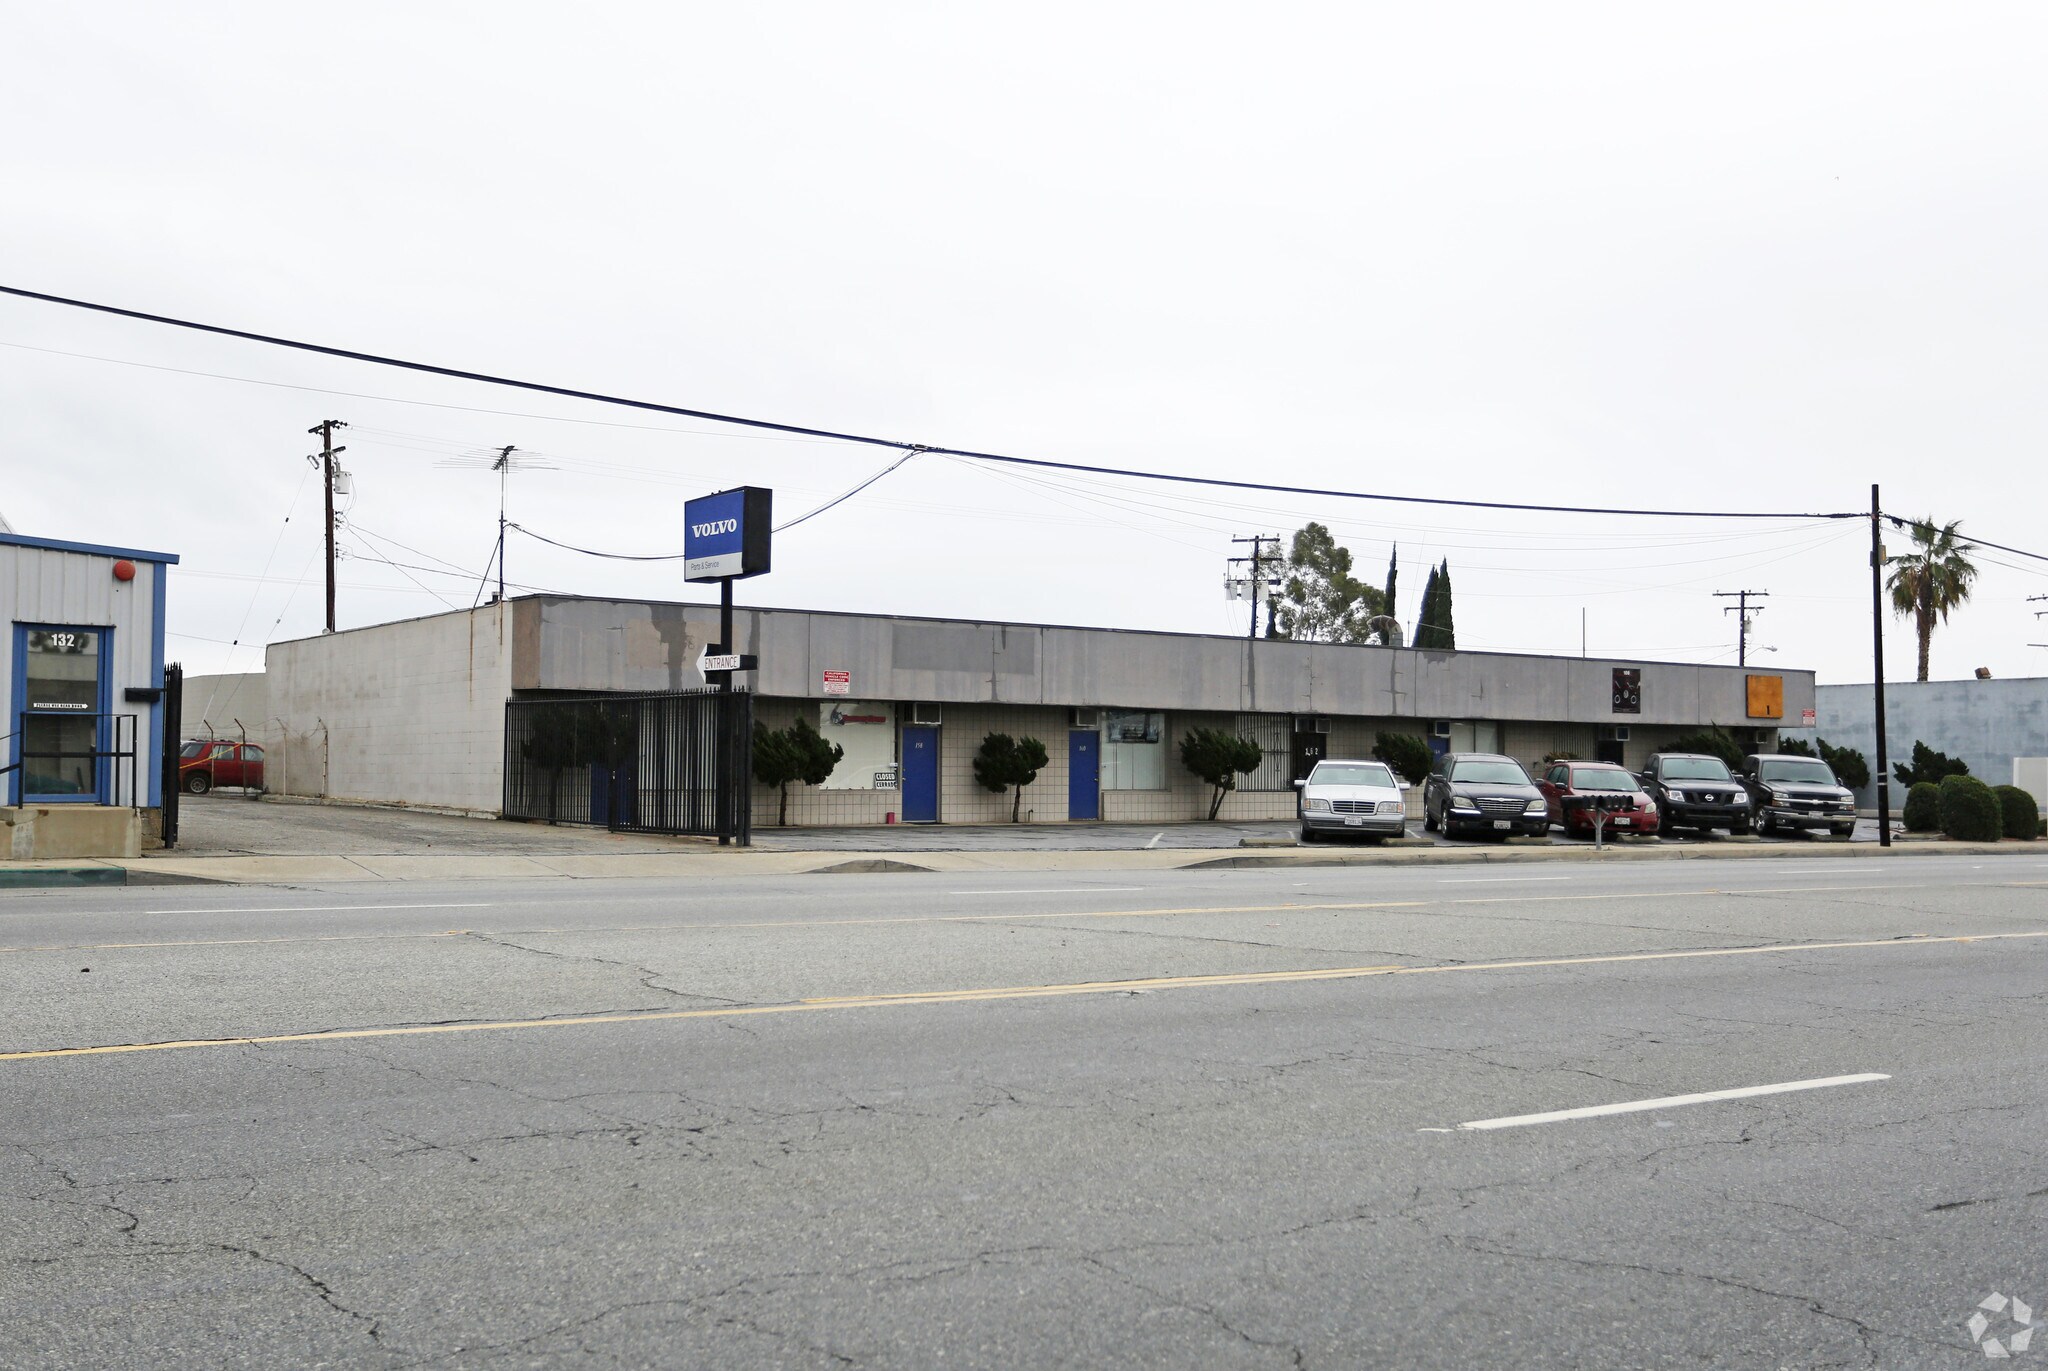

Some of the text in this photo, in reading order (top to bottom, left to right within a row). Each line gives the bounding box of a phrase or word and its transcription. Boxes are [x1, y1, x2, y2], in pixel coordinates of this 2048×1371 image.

[692, 518, 738, 538] VOLVO
[691, 563, 701, 571] Parts
[705, 561, 719, 570] Service
[51, 633, 75, 647] 132
[705, 656, 738, 670] ENTRANCE
[876, 773, 896, 781] CLOSED
